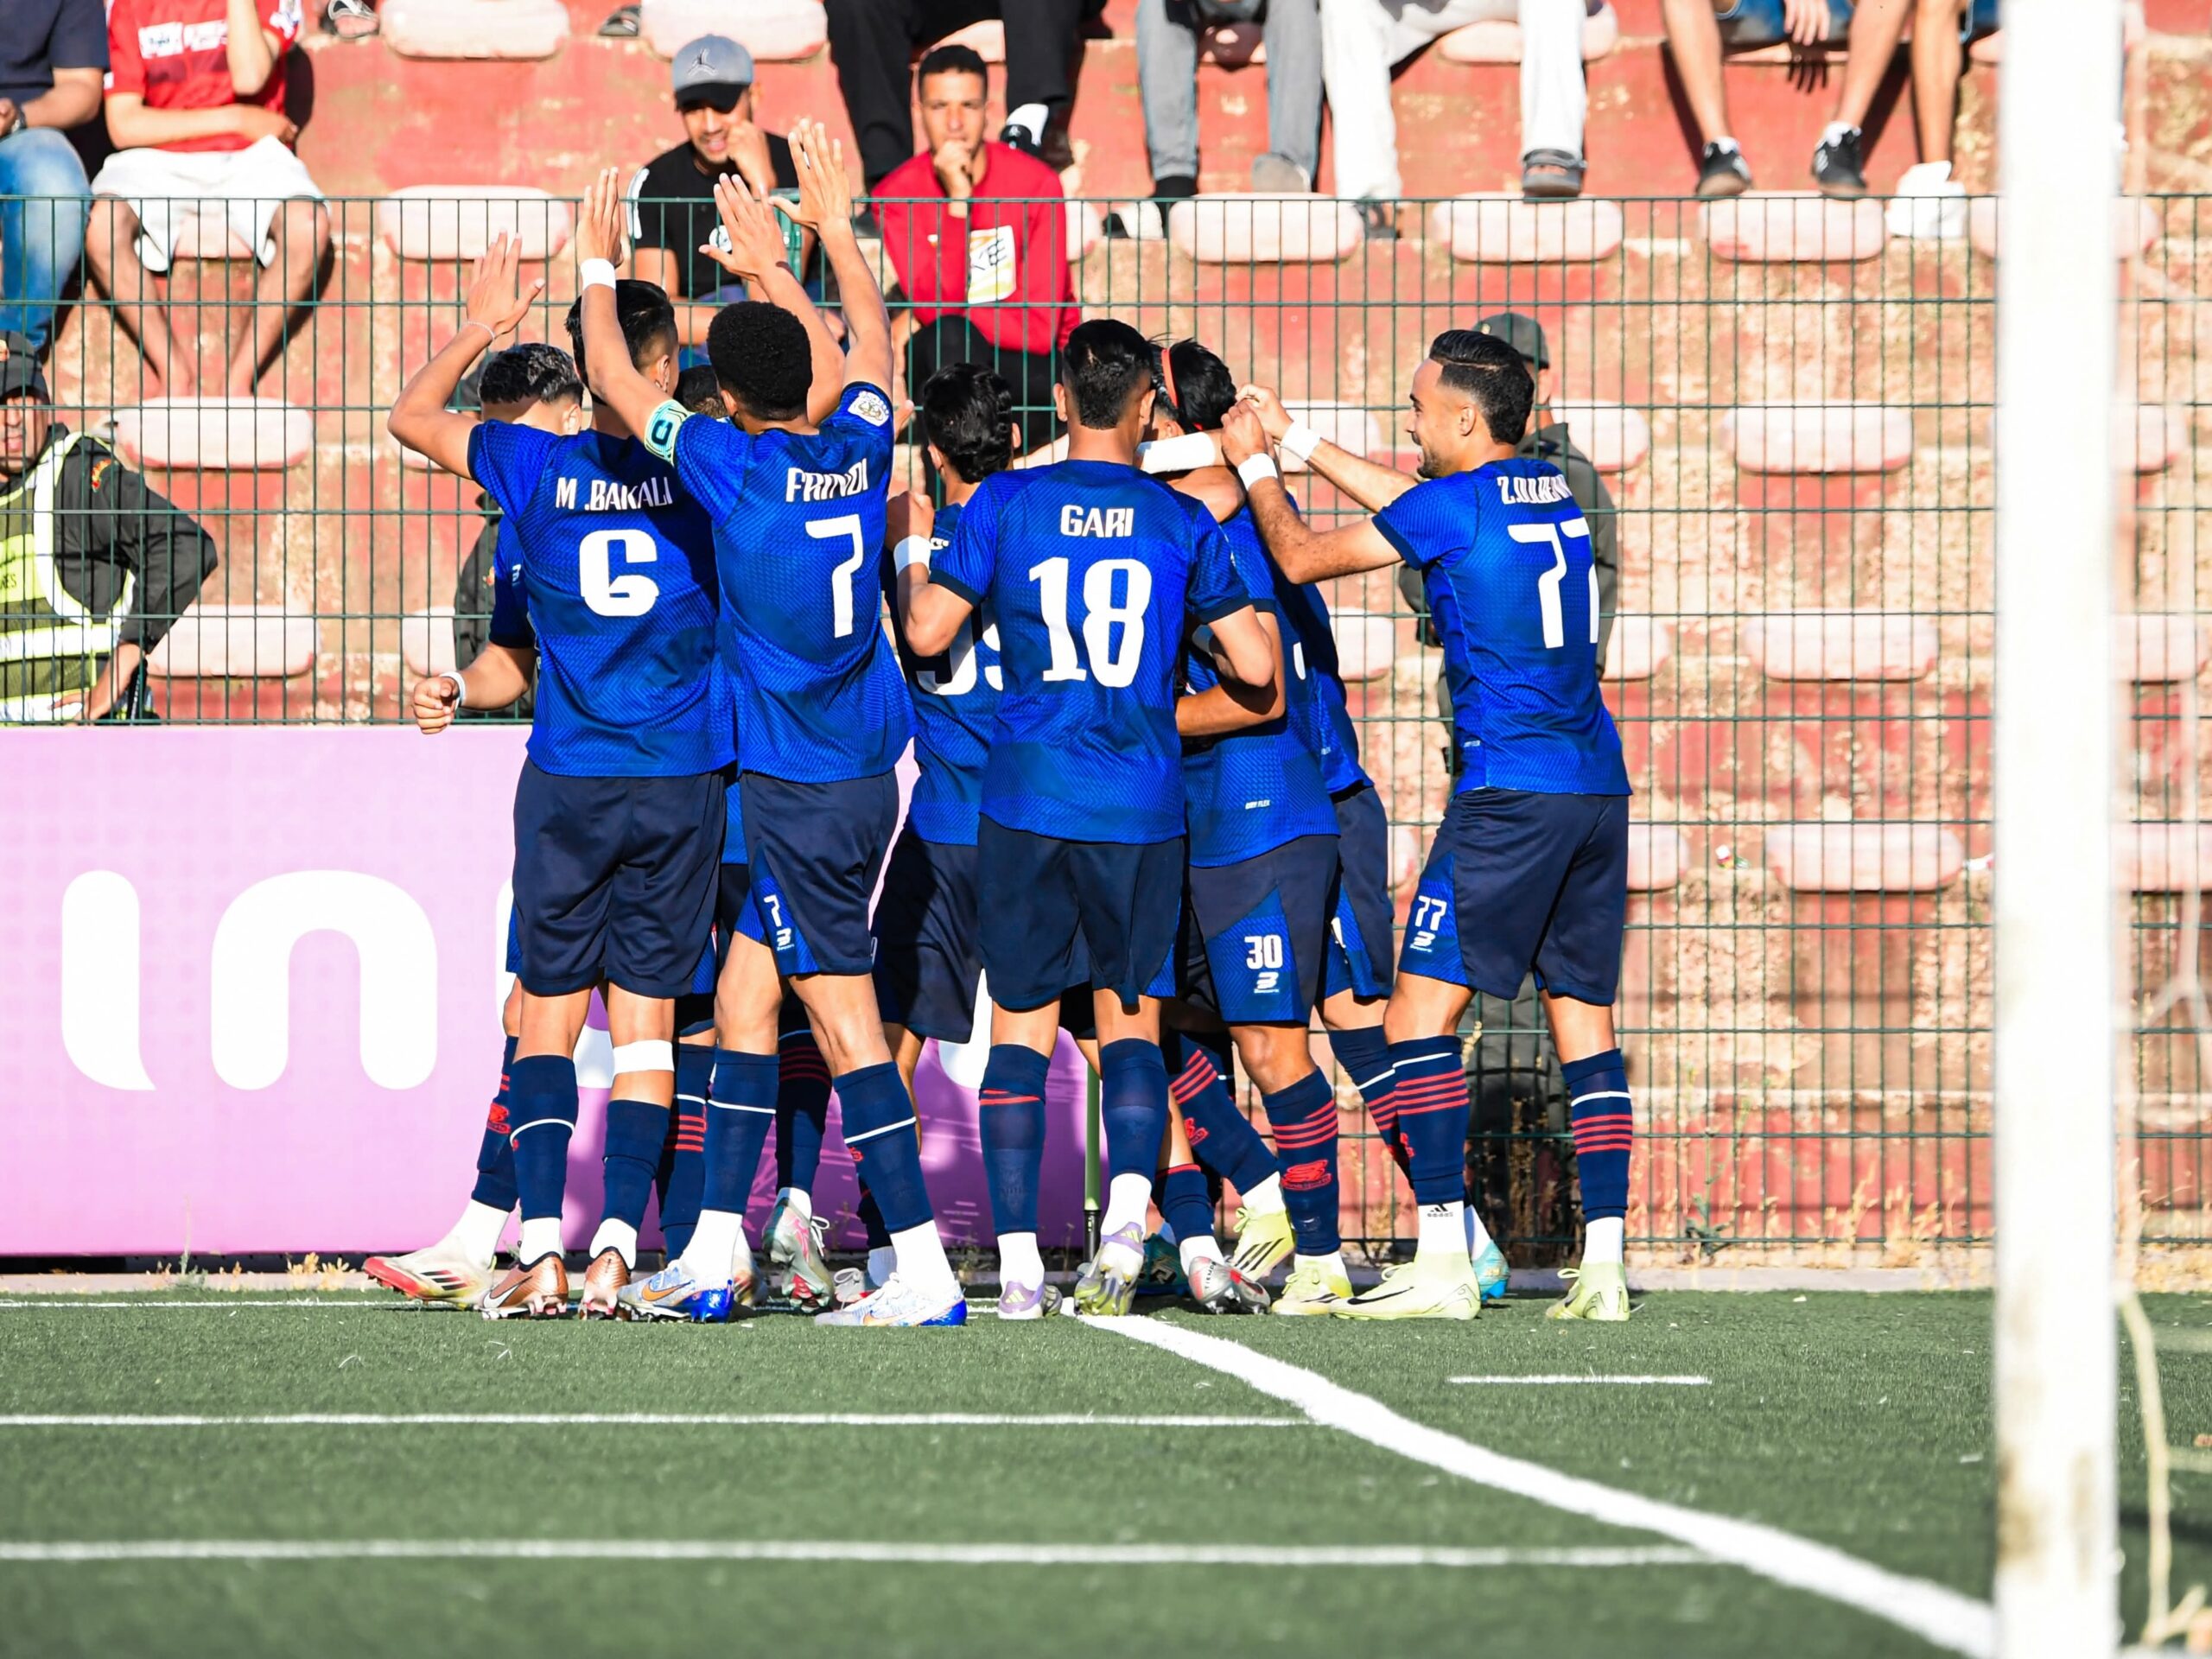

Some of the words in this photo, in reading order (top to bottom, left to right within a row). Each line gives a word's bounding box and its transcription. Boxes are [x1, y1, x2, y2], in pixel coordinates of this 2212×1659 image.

[556, 476, 578, 510] M
[785, 457, 869, 503] FRINDI
[1060, 504, 1135, 538] GARI
[579, 529, 660, 617] 6
[804, 513, 864, 639] 7
[1507, 517, 1599, 649] 77
[1028, 556, 1153, 689] 18
[763, 894, 782, 927] 7
[1414, 895, 1447, 931] 77
[1244, 934, 1283, 969] 30
